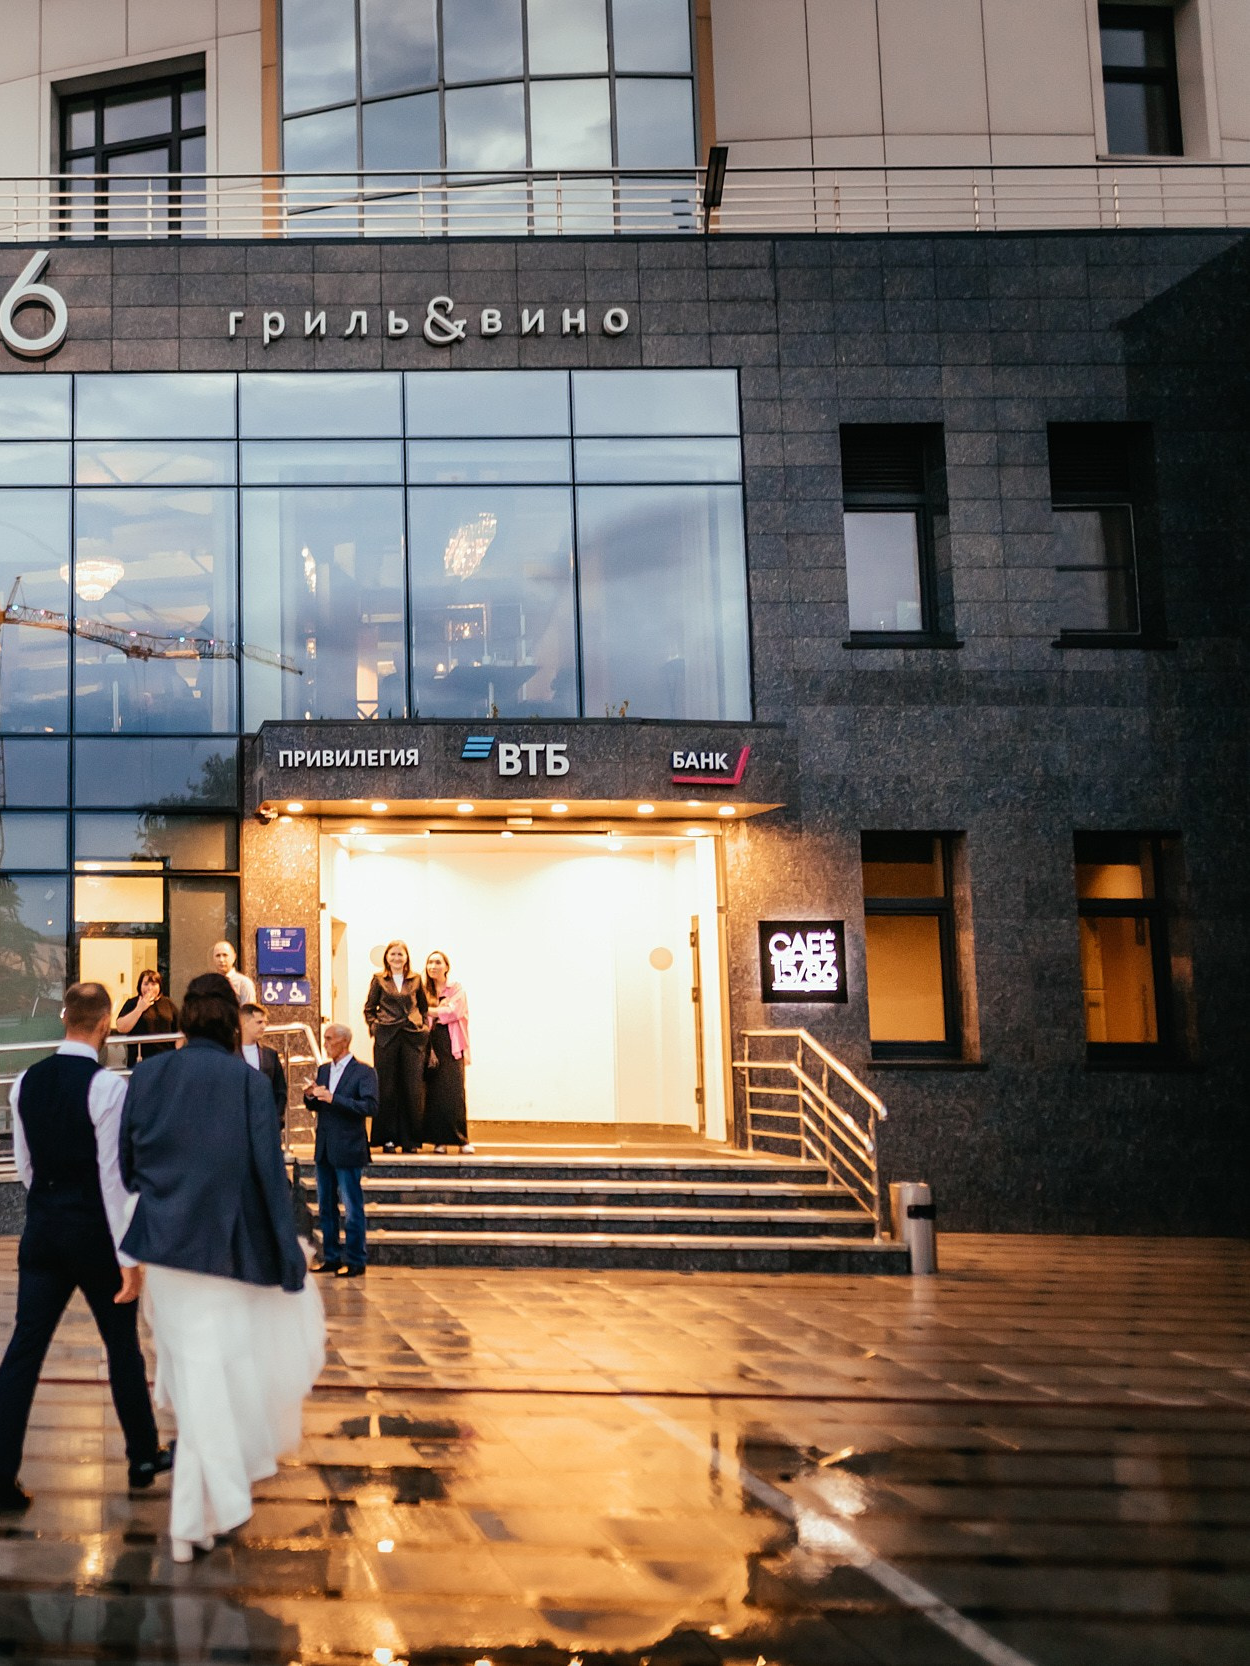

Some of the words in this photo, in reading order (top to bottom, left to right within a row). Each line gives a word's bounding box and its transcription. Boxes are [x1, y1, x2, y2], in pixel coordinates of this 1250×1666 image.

[228, 296, 629, 345] гриль&вино
[277, 747, 420, 770] ПРИВИЛЕГИЯ
[497, 742, 570, 777] ВТБ
[671, 750, 729, 771] БАНК
[769, 929, 836, 956] CAFÉ
